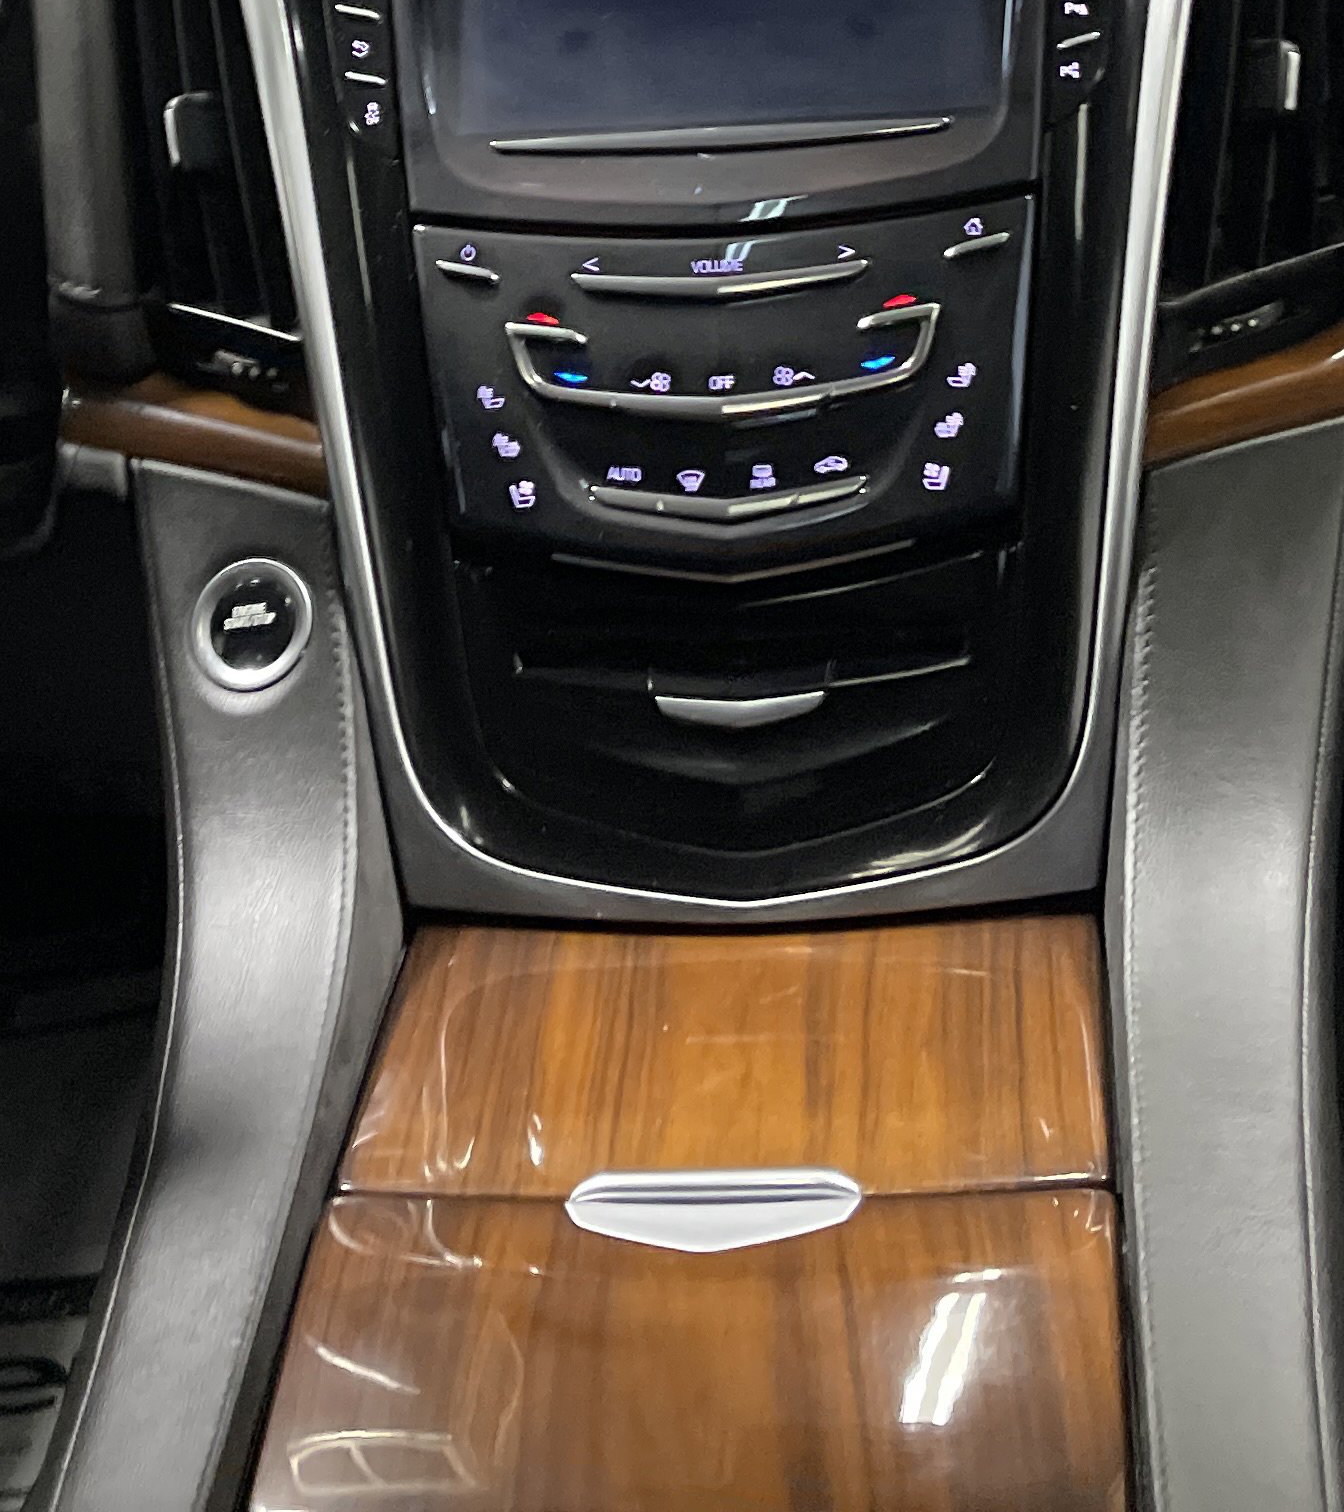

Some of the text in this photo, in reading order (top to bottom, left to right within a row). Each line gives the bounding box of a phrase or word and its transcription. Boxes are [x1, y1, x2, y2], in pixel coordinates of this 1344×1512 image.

[690, 258, 744, 274] VOLUME
[708, 375, 735, 390] OFF
[606, 466, 642, 482] AUTO
